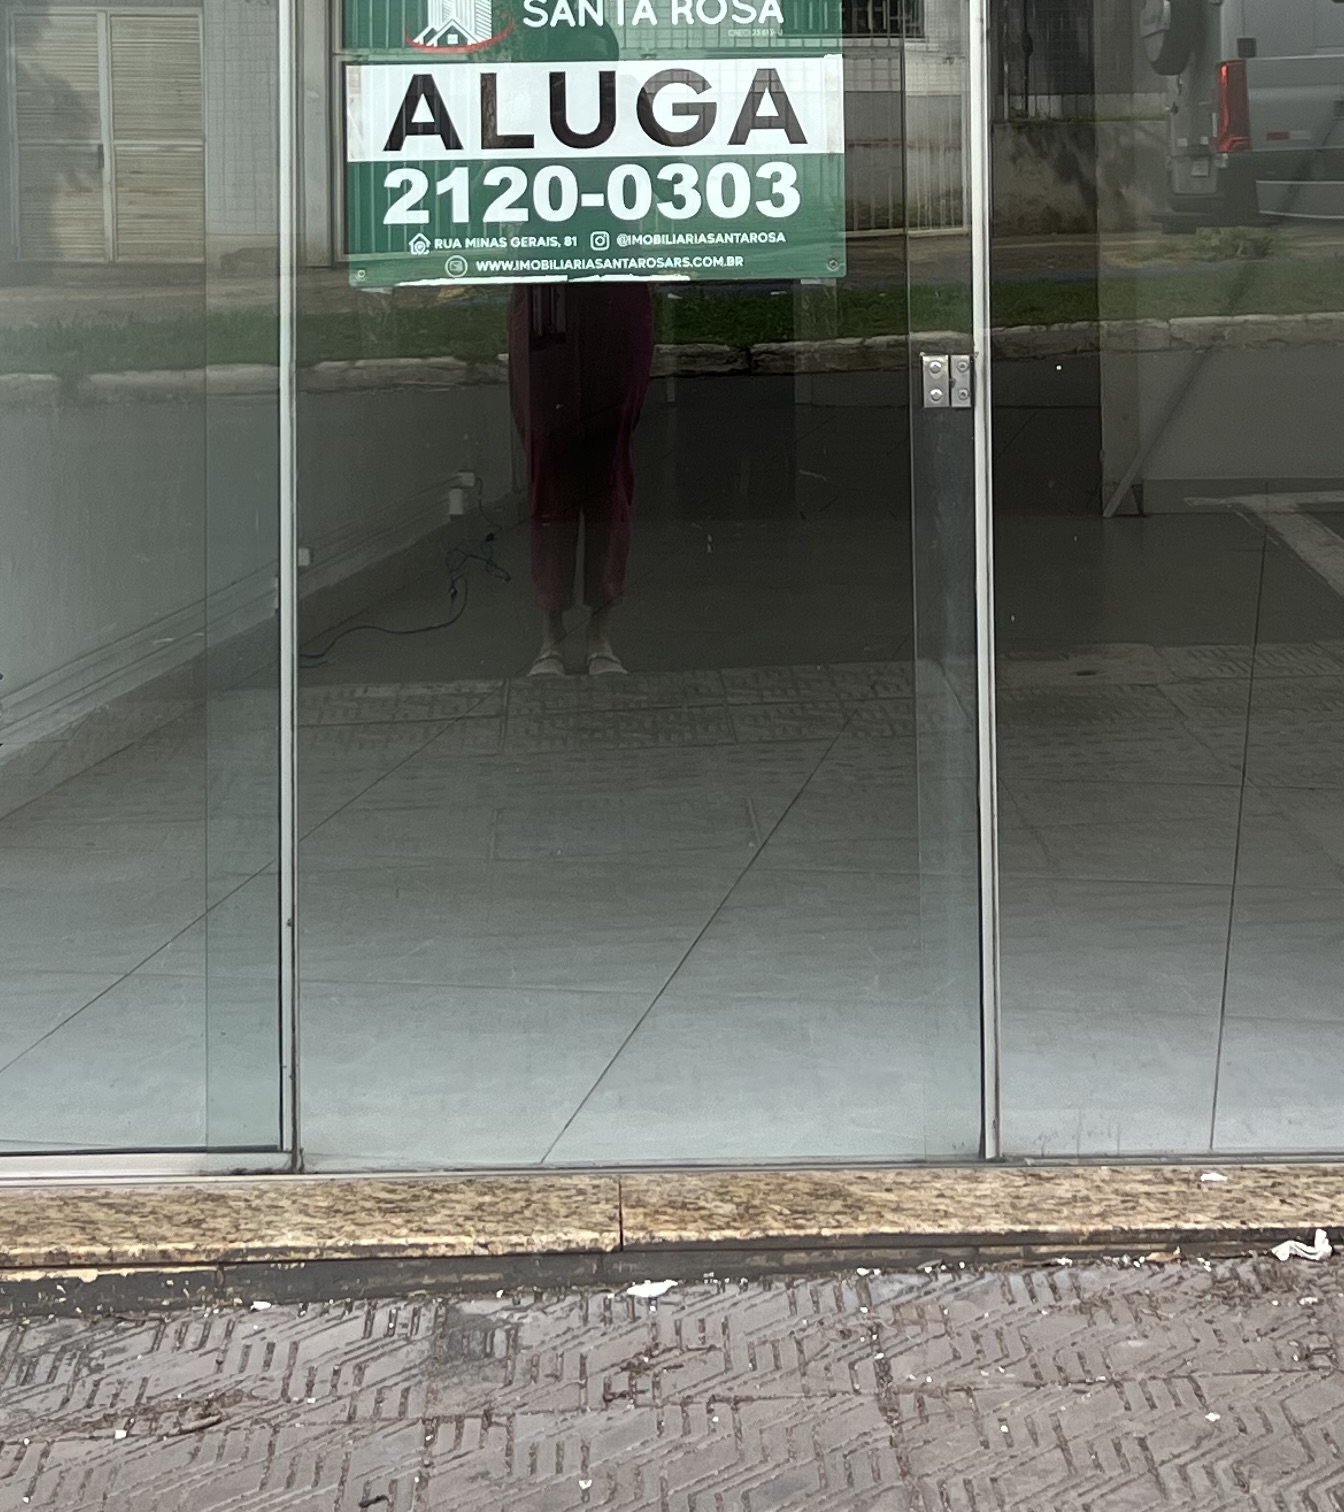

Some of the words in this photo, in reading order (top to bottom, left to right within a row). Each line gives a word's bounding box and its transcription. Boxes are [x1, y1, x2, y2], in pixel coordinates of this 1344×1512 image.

[383, 67, 809, 152] ALUGA
[382, 161, 802, 226] 2120-0303
[434, 237, 462, 249] RUA
[465, 236, 507, 249] MINAS
[510, 235, 562, 248] GERAIS,
[563, 235, 578, 247] 81
[616, 231, 787, 247] @IMOBILIARIASANTAROSA
[475, 255, 744, 272] WWW.IMOBILIARIASANTAROSARS.COM.BR
